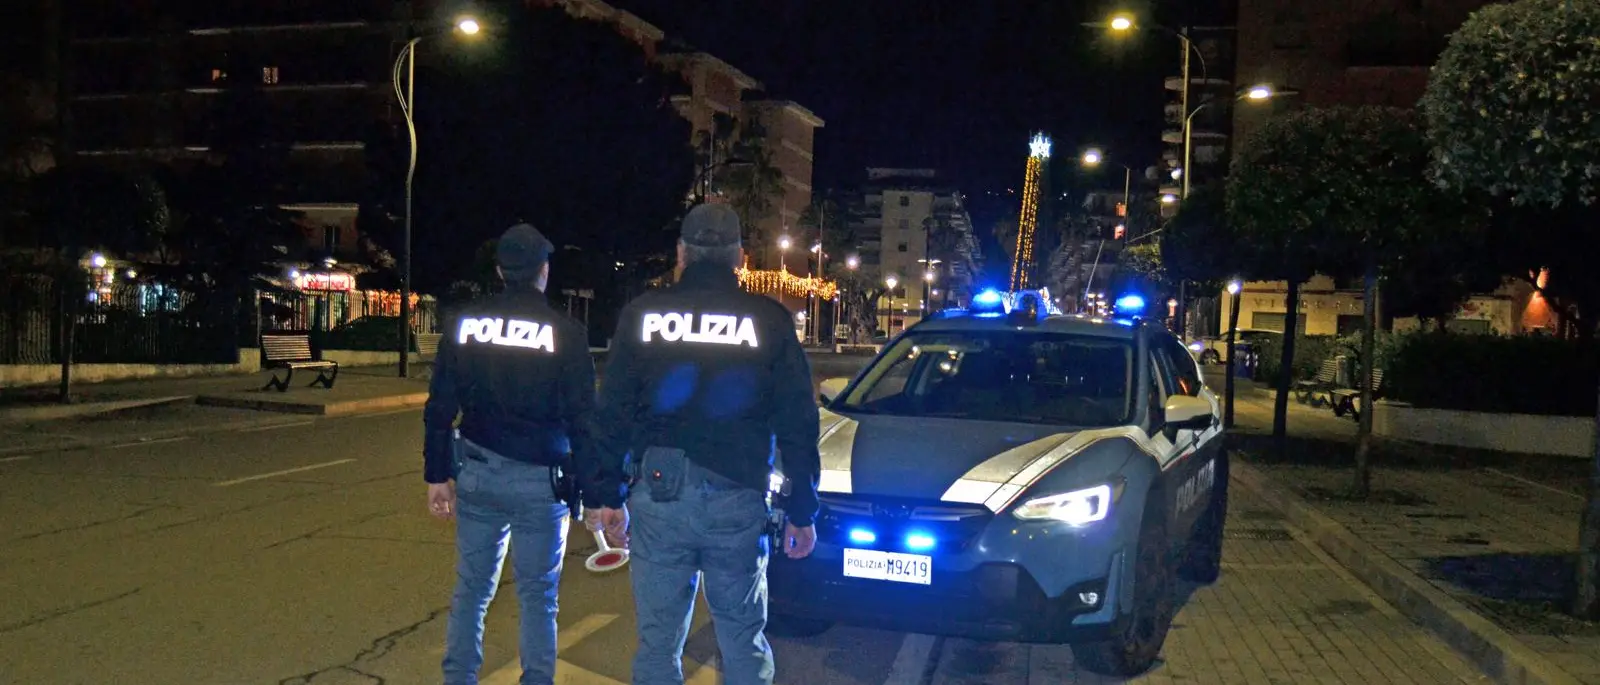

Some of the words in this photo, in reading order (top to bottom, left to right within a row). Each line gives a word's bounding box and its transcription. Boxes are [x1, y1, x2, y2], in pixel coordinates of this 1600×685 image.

[460, 317, 555, 352] POLIZIA
[643, 313, 758, 347] POLIZIA
[847, 558, 883, 569] POLIZIA
[886, 558, 928, 578] M9419
